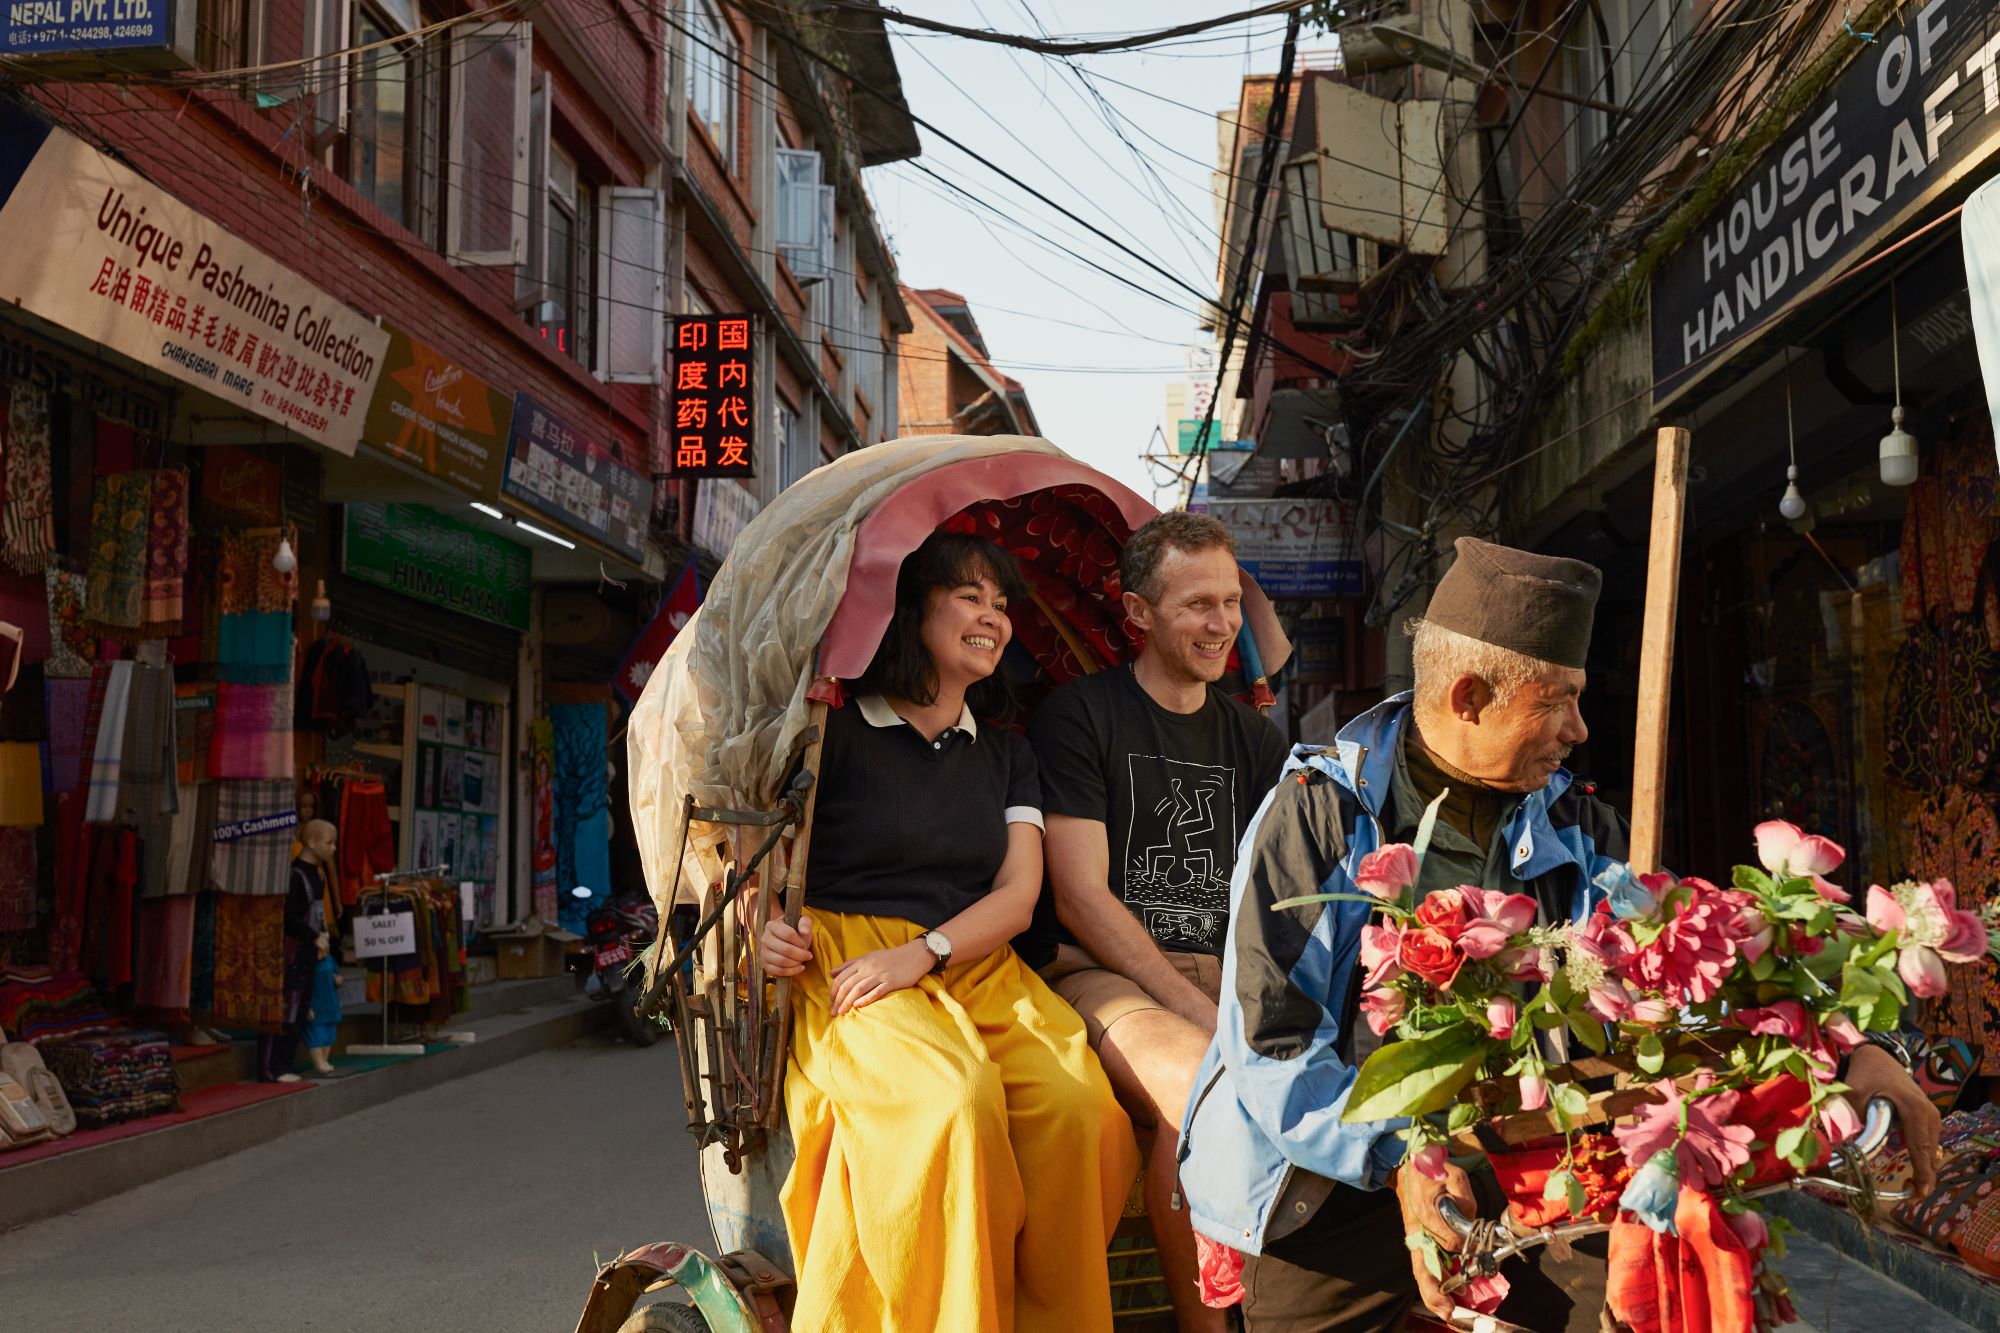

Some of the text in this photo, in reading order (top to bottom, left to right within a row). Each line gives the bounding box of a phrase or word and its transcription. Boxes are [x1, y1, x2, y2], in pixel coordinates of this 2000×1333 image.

[10, 0, 152, 26] NEPAL PVT. LTD.
[114, 24, 153, 37] 4246949
[1702, 0, 1948, 283] HOUSE OF
[1683, 30, 2000, 366] HANDICRAFT
[97, 186, 374, 383] Unique Pashmina Collection
[161, 341, 254, 397] CHAKSIBARI MARG
[676, 322, 708, 468] 印度药品
[717, 319, 749, 467] 国内代发
[392, 557, 511, 622] HIMALAYAN
[213, 813, 297, 841] 100% Cashmere
[371, 919, 396, 930] SALE!
[387, 934, 405, 945] OFF
